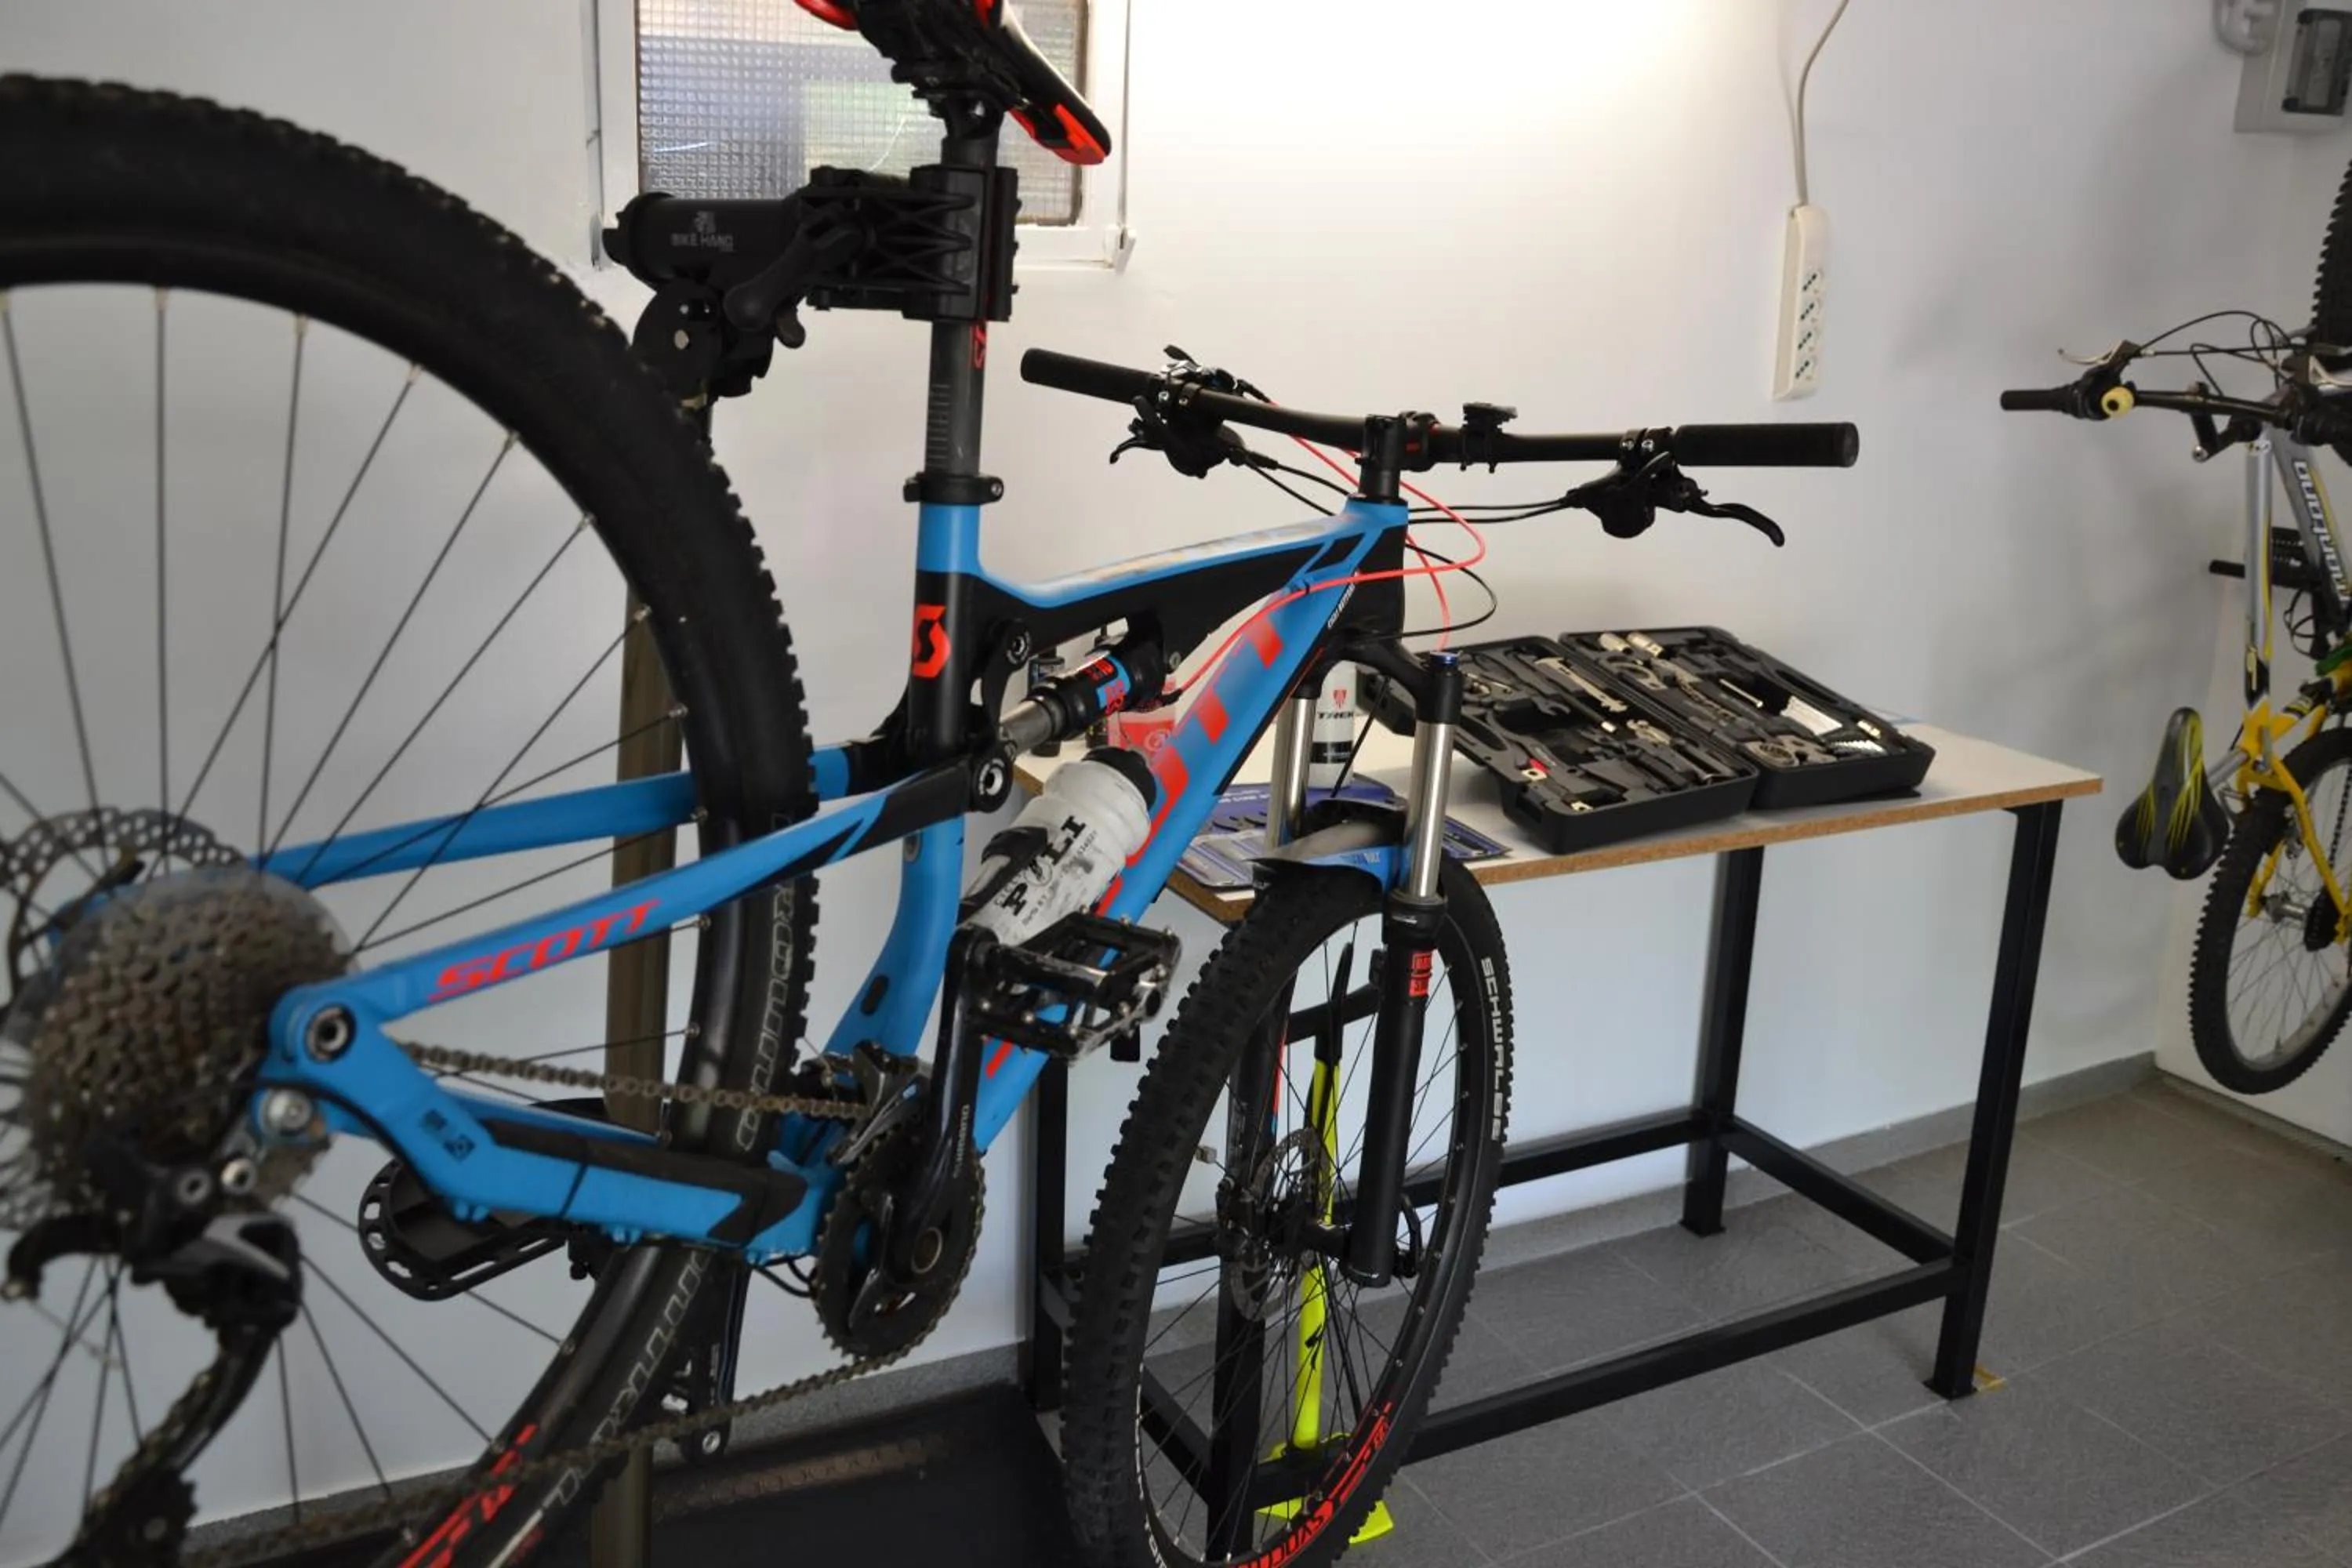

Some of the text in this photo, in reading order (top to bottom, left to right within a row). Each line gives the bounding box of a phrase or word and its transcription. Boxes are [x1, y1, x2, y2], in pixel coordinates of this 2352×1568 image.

[671, 233, 734, 248] BIKE HAND
[1318, 711, 1354, 720] TREK
[429, 898, 662, 1003] SCOTT
[1480, 957, 1504, 1142] SCHWALBE
